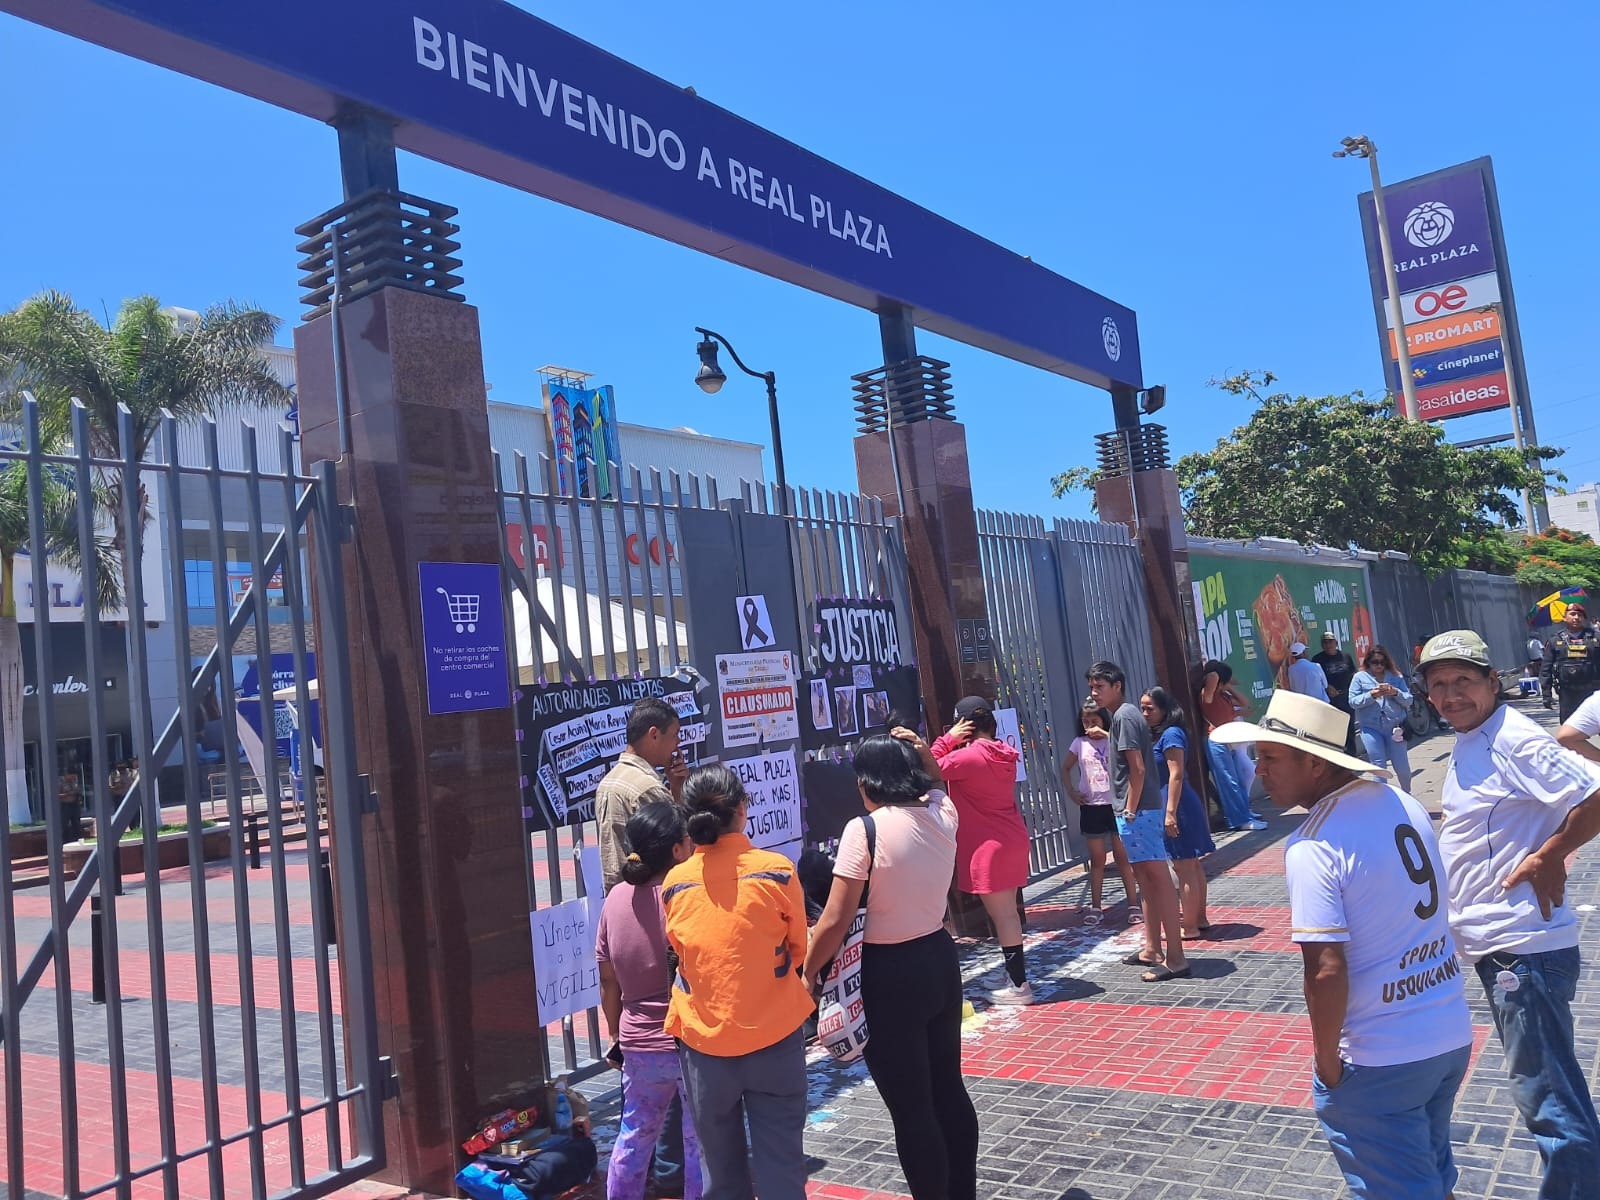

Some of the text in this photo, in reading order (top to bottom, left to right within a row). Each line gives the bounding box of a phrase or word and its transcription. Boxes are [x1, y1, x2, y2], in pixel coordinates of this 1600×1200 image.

[413, 17, 893, 258] BIENVENIDO A REAL PLAZA
[1430, 243, 1479, 264] PLAZA
[1414, 285, 1468, 316] oe
[1415, 317, 1493, 345] PROMART
[1437, 349, 1500, 371] cineplanet
[1417, 385, 1500, 411] asaideas
[821, 607, 901, 666] JUSTICIA
[1437, 635, 1464, 647] NIKE
[445, 646, 464, 654] retirar
[477, 645, 500, 653] coches
[454, 655, 479, 663] compra
[441, 661, 495, 671] centro comercial
[532, 679, 665, 721] AUTORIDADES INEPTAS
[665, 692, 693, 705] ONGRESO
[726, 691, 791, 715] CLAUSURADO
[679, 727, 697, 741] EIKO
[763, 759, 792, 780] PLAZA
[568, 779, 588, 796] Diego
[772, 780, 796, 804] MAS!
[747, 806, 793, 839] JUSTICIA!
[1394, 824, 1438, 920] 9
[558, 945, 582, 964] a la
[1400, 935, 1446, 969] SPORT
[538, 967, 598, 1007] VIGILI
